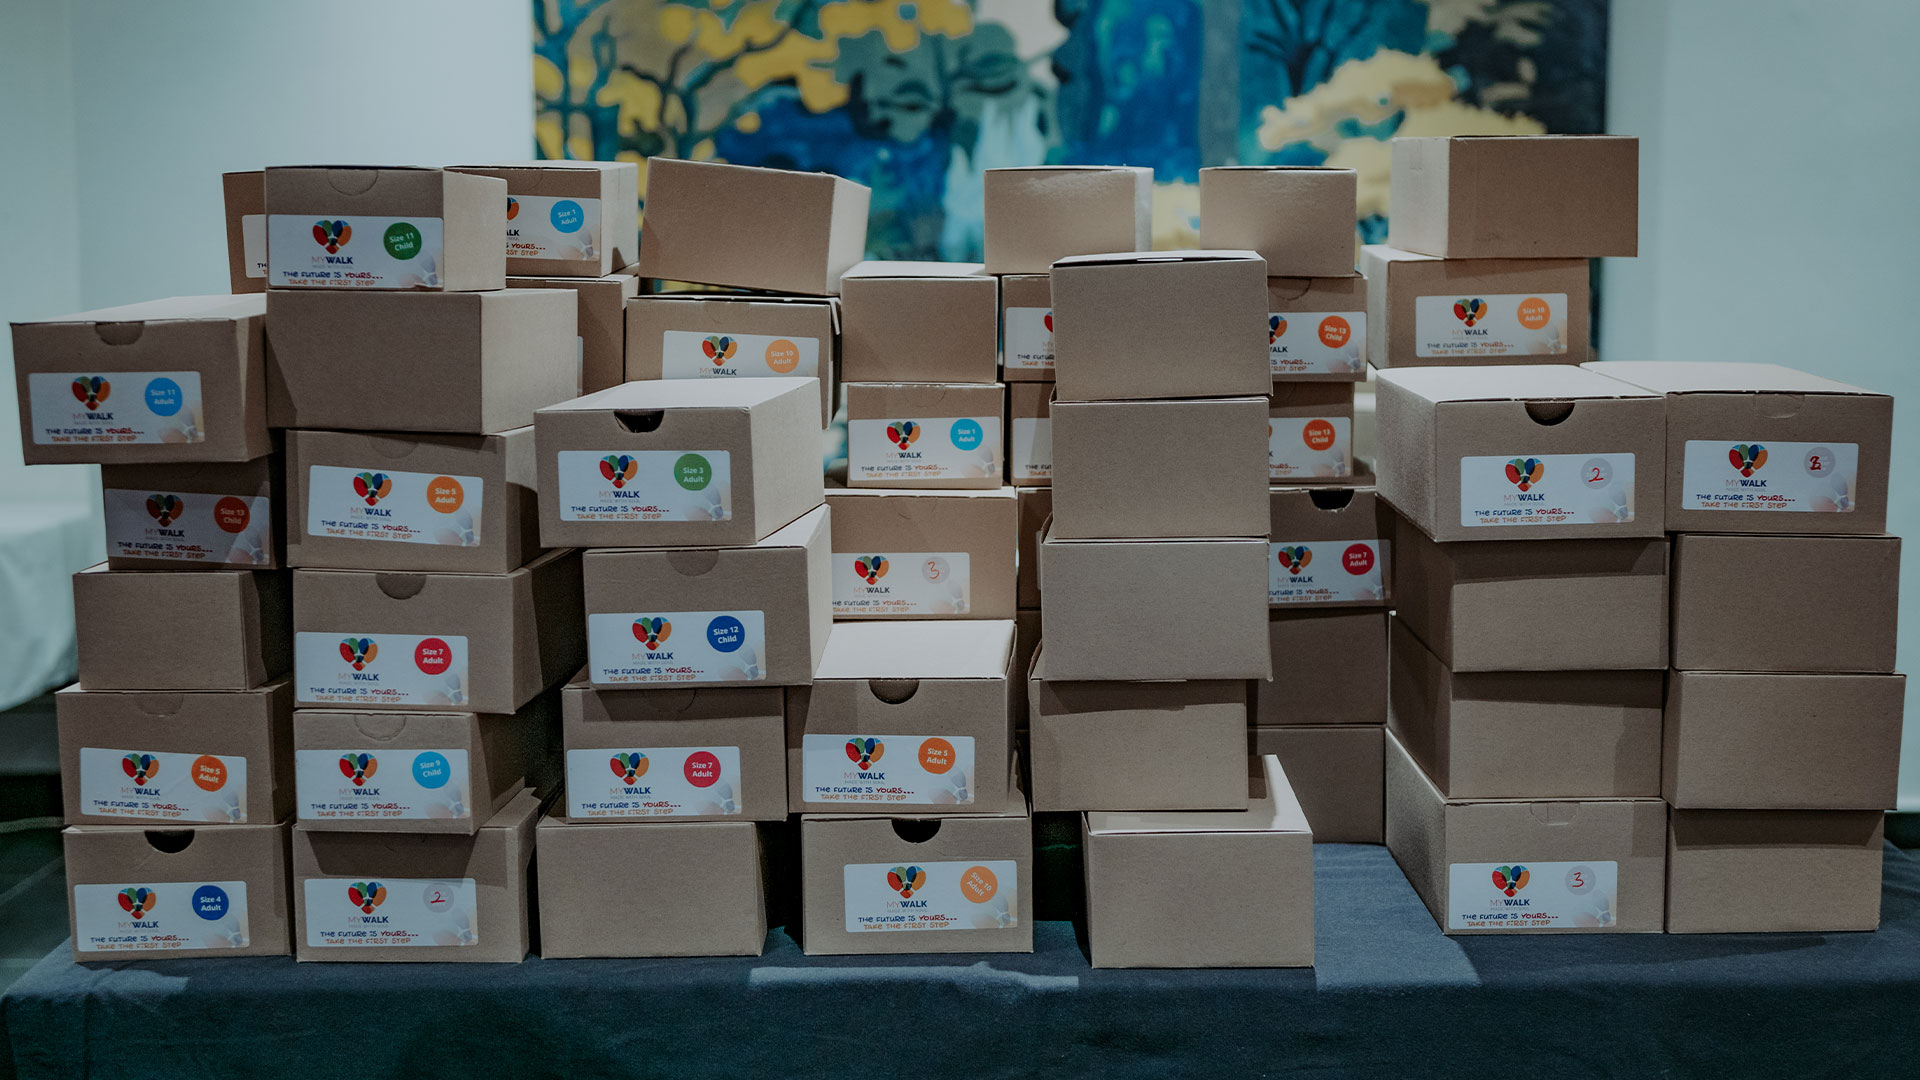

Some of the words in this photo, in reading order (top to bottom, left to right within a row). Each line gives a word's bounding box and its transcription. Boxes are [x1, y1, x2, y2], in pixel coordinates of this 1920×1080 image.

[561, 217, 577, 225] Adult
[389, 234, 404, 243] Size
[406, 232, 414, 240] 11
[395, 242, 414, 251] Child
[1325, 333, 1342, 341] Child
[1308, 429, 1321, 437] Size
[683, 475, 704, 483] Adult
[1587, 467, 1604, 482] 2
[223, 516, 241, 524] Child
[928, 561, 940, 579] 3
[713, 628, 729, 636] Size
[717, 635, 737, 644] Child
[422, 657, 444, 665] Adult
[927, 748, 942, 756] Size
[927, 757, 947, 765] Adult
[200, 765, 215, 773] Size
[422, 769, 442, 778] Child
[199, 774, 219, 783] Adult
[970, 871, 984, 884] Size
[984, 882, 992, 891] 10
[1572, 871, 1585, 888] 3
[967, 880, 984, 896] Adult
[430, 891, 446, 904] 2
